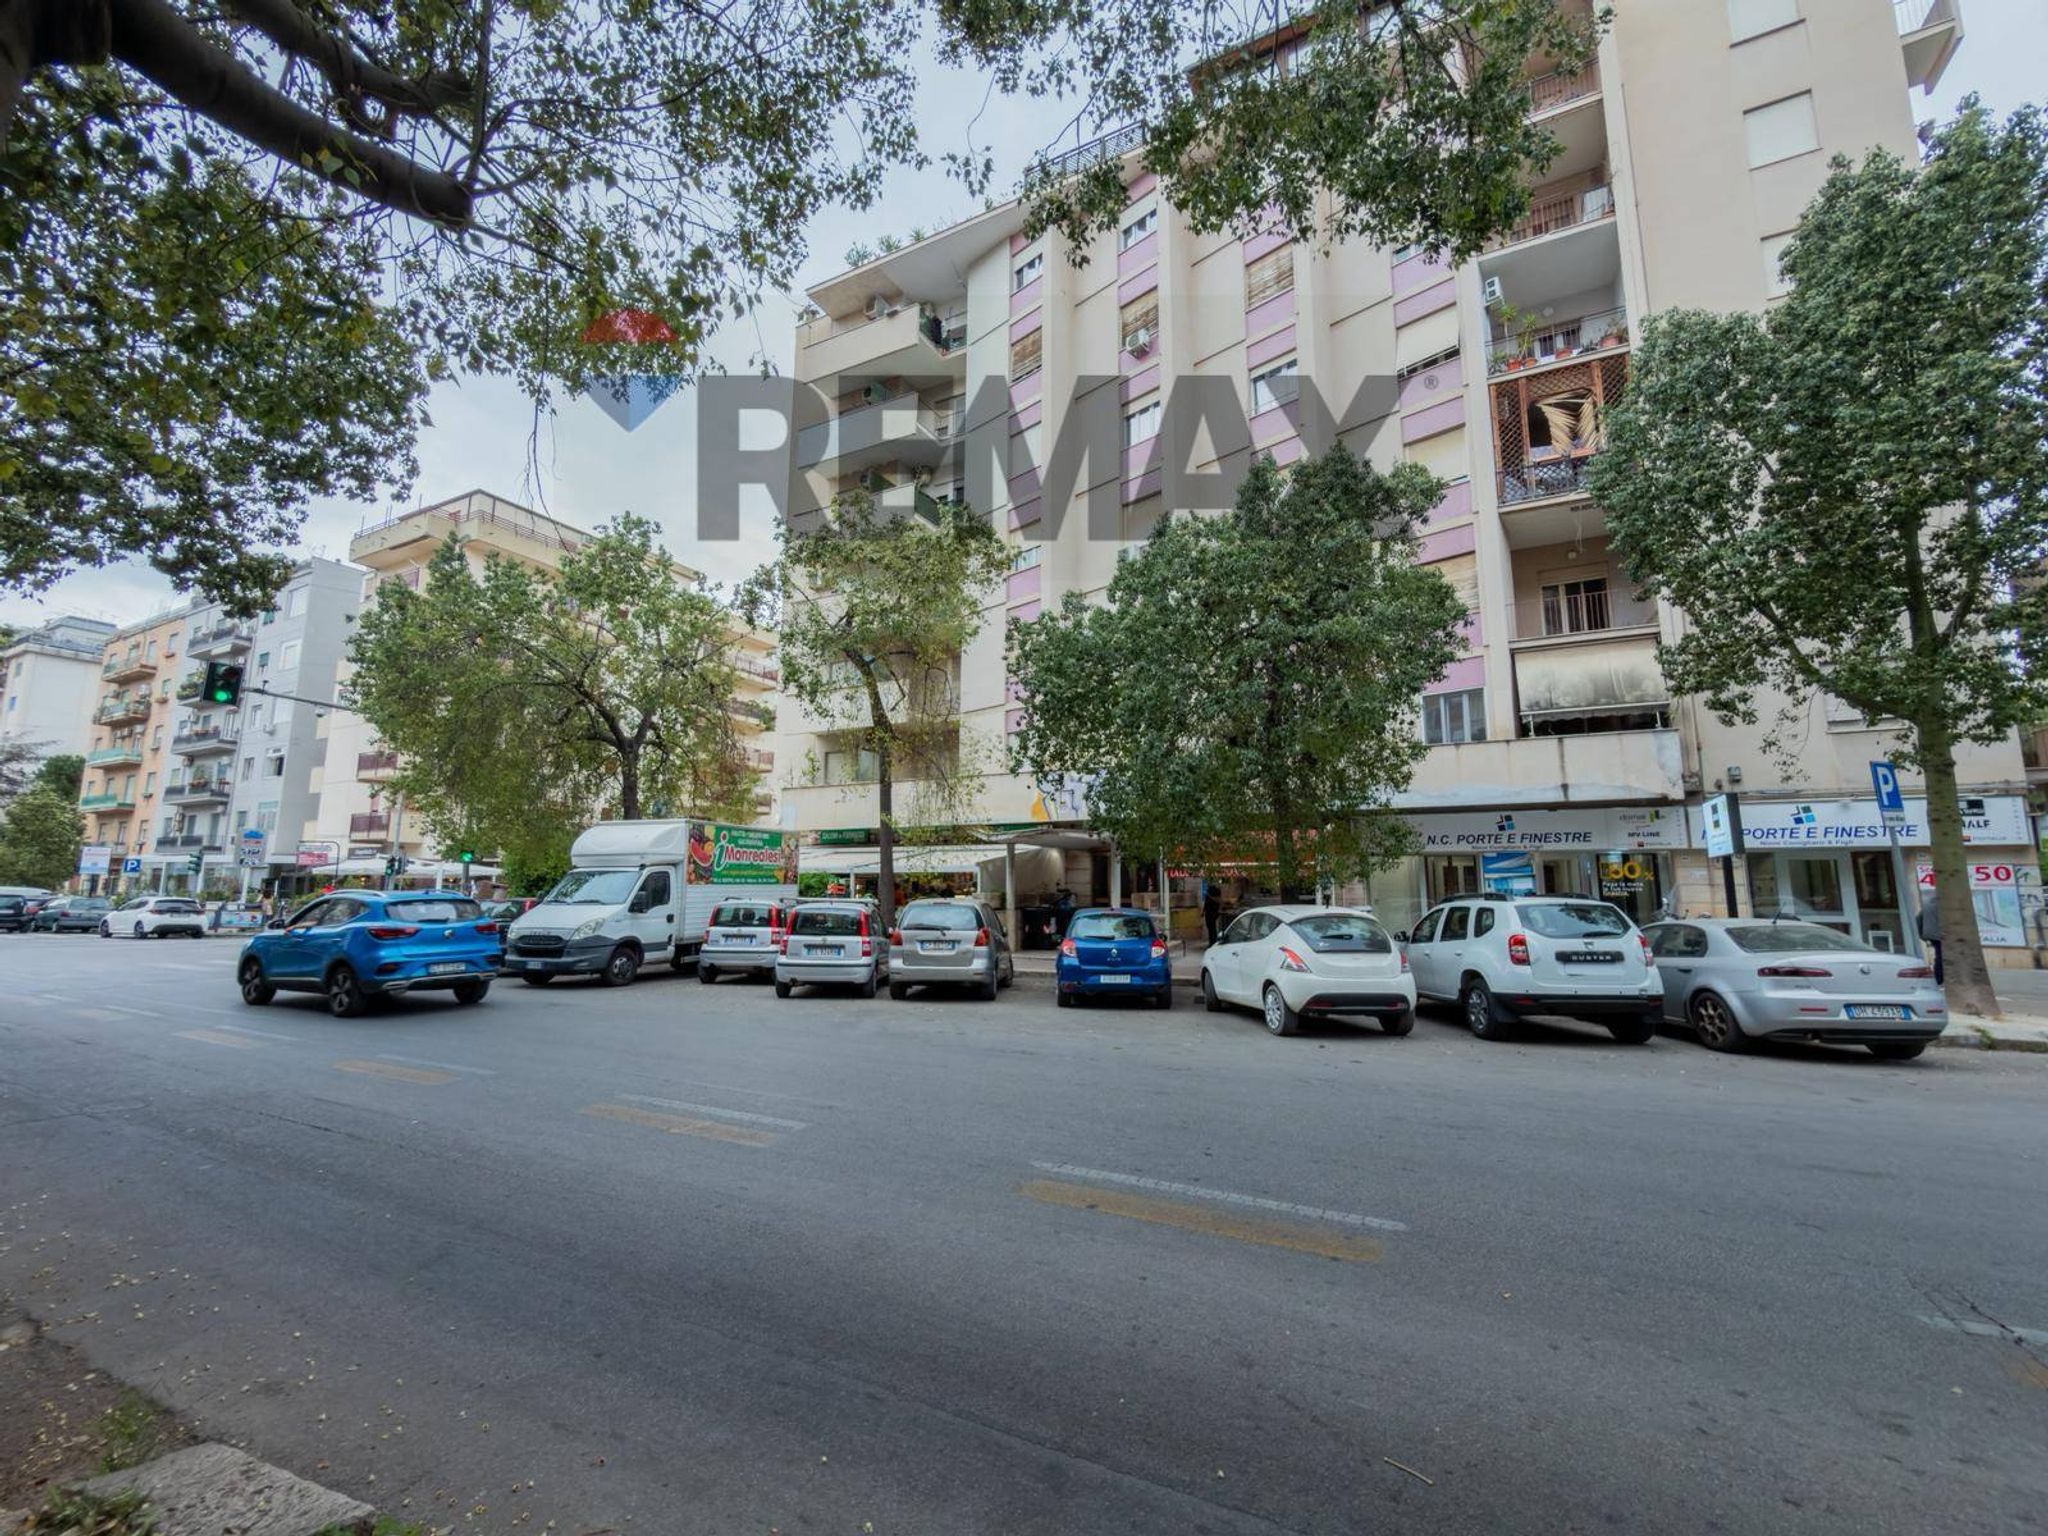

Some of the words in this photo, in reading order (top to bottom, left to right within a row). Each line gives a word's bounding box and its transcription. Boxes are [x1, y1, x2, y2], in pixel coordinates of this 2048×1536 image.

[1876, 766, 1894, 806] P
[1427, 834, 1452, 846] N.C.
[1457, 833, 1504, 845] PORTE
[1507, 833, 1517, 844] E
[1520, 831, 1593, 844] FINESTRE
[1741, 826, 1800, 840] PORTE
[1806, 826, 1819, 839] E
[127, 860, 137, 871] P
[1974, 865, 2012, 882] 50
